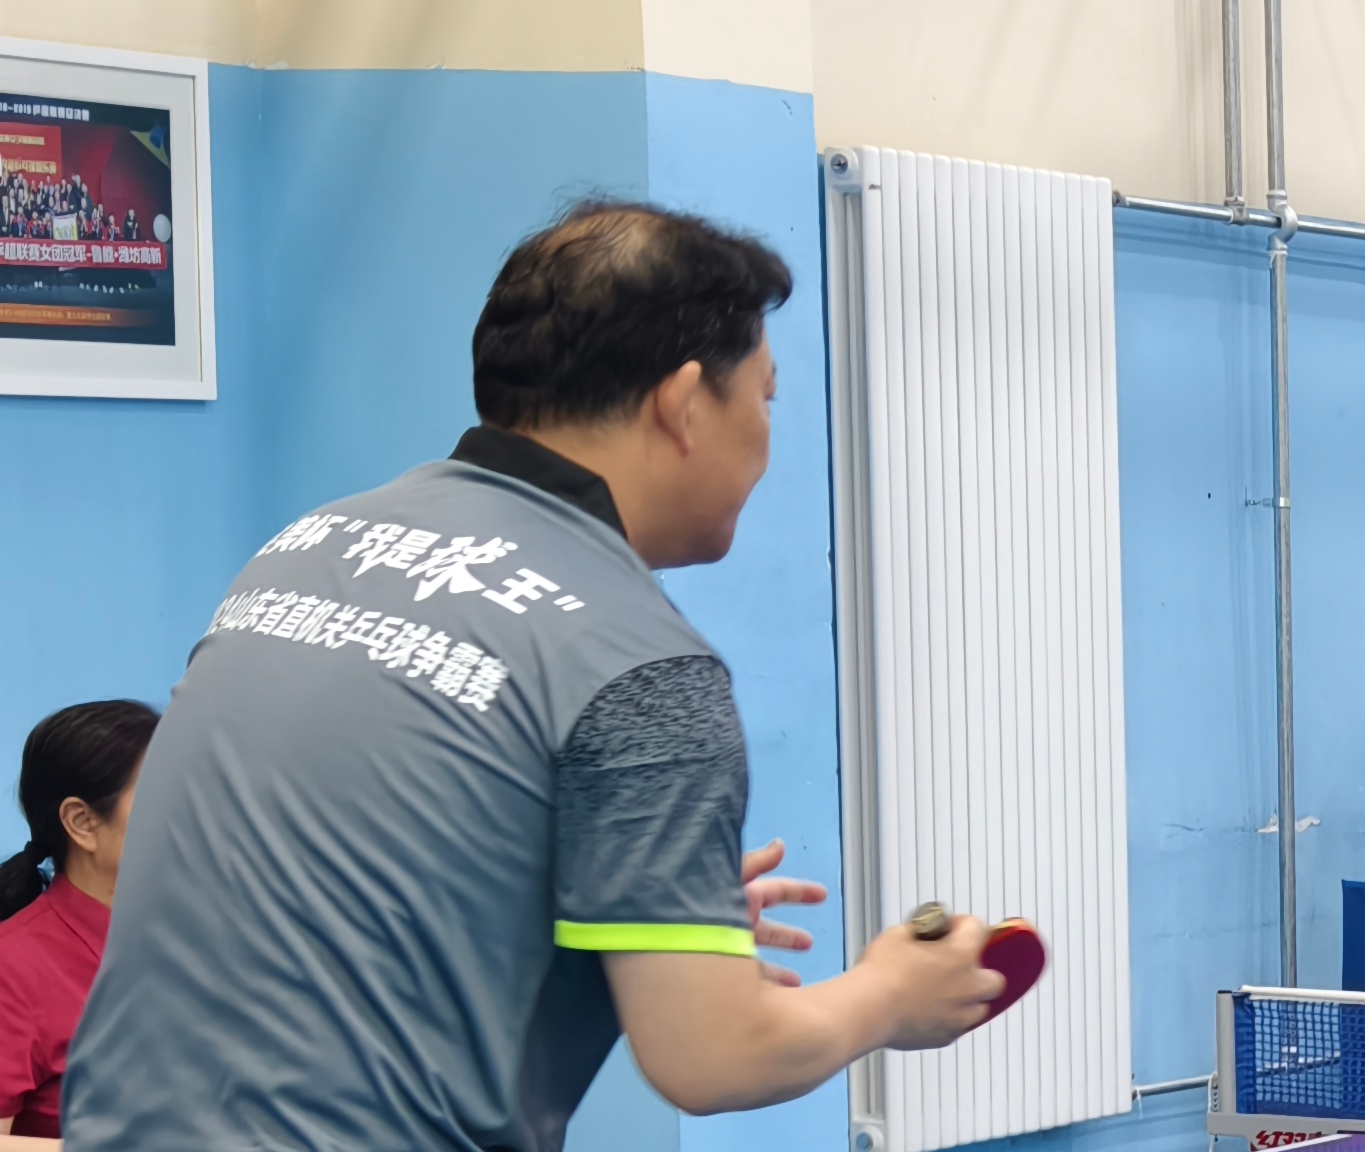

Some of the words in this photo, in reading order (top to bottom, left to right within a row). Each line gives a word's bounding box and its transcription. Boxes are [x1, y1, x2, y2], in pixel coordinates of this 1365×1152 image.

[255, 513, 587, 614] 美杯“我是球王”
